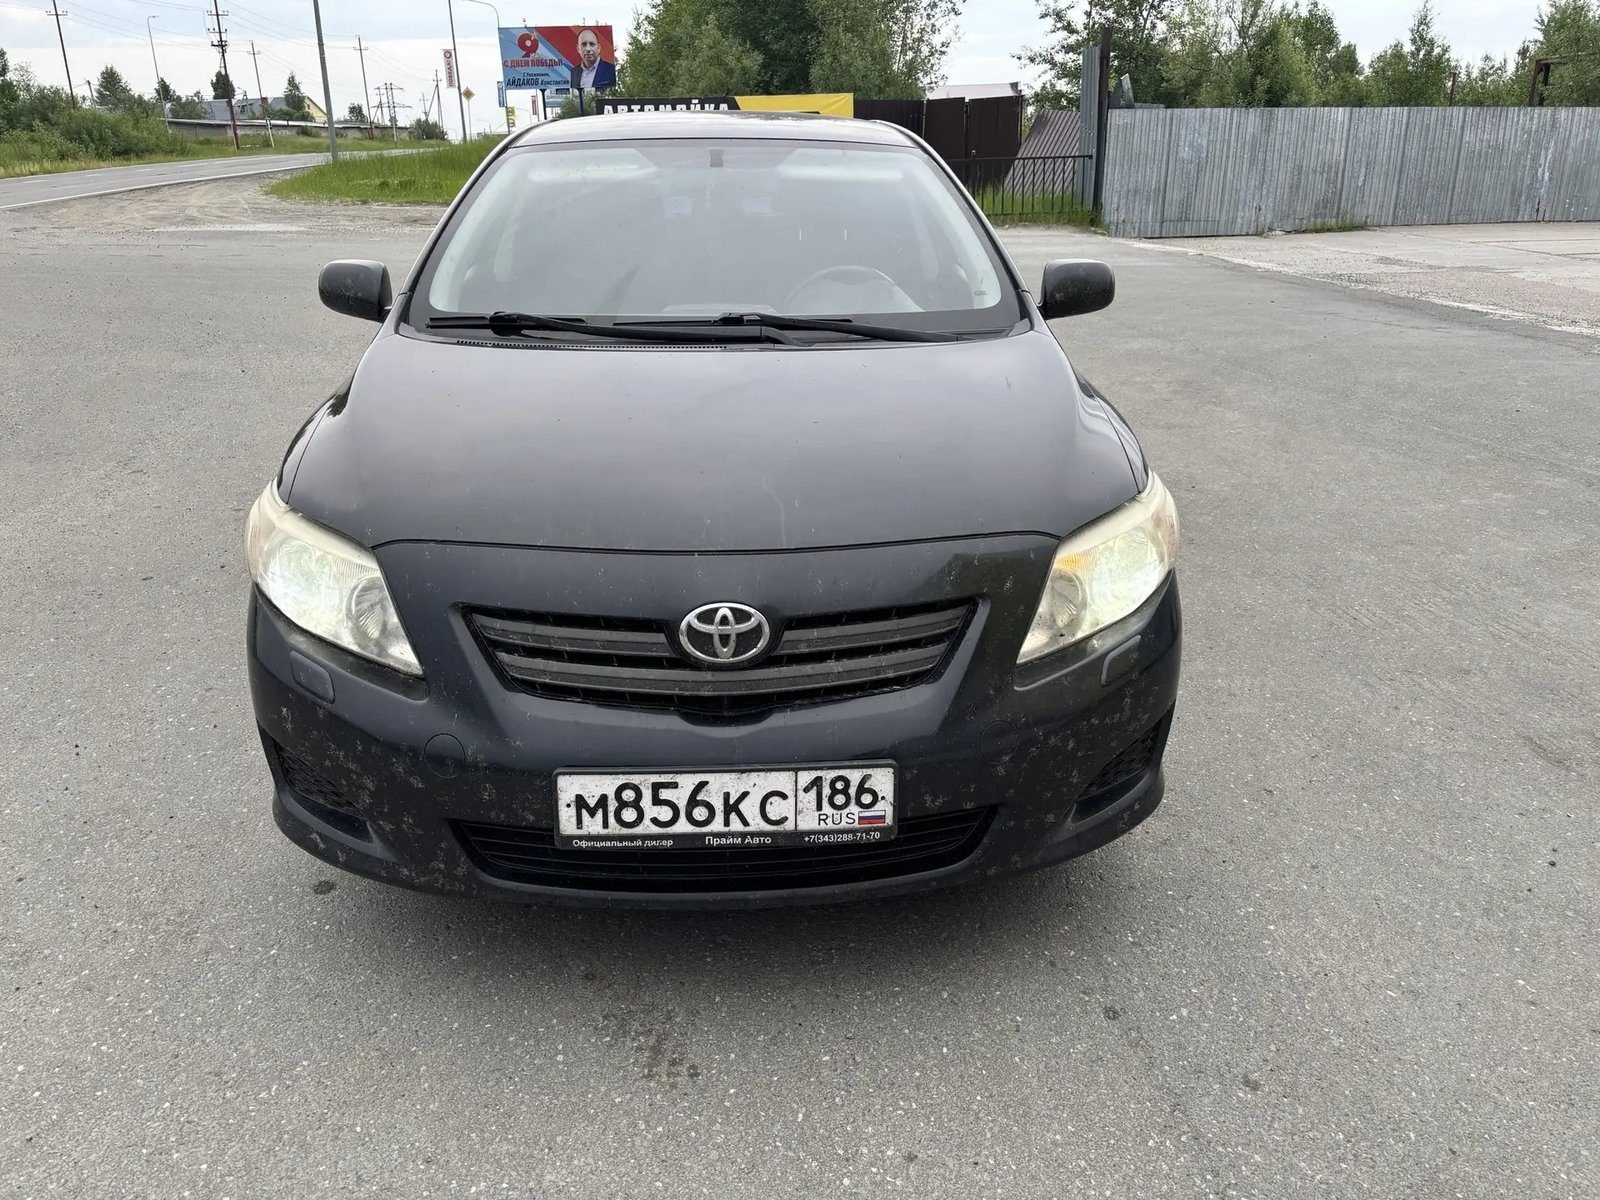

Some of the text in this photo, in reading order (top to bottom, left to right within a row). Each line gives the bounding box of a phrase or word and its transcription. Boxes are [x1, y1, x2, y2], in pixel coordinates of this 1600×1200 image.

[518, 32, 539, 58] 9
[511, 59, 530, 68] ДНЕМ
[506, 77, 539, 87] АЙДАКОВ
[575, 774, 879, 830] М856КС 186
[817, 812, 857, 826] RUS
[572, 839, 642, 848] Официальный
[705, 835, 742, 845] Прайм
[745, 835, 772, 845] Авто
[804, 831, 881, 843] +7(343)288-71-70
